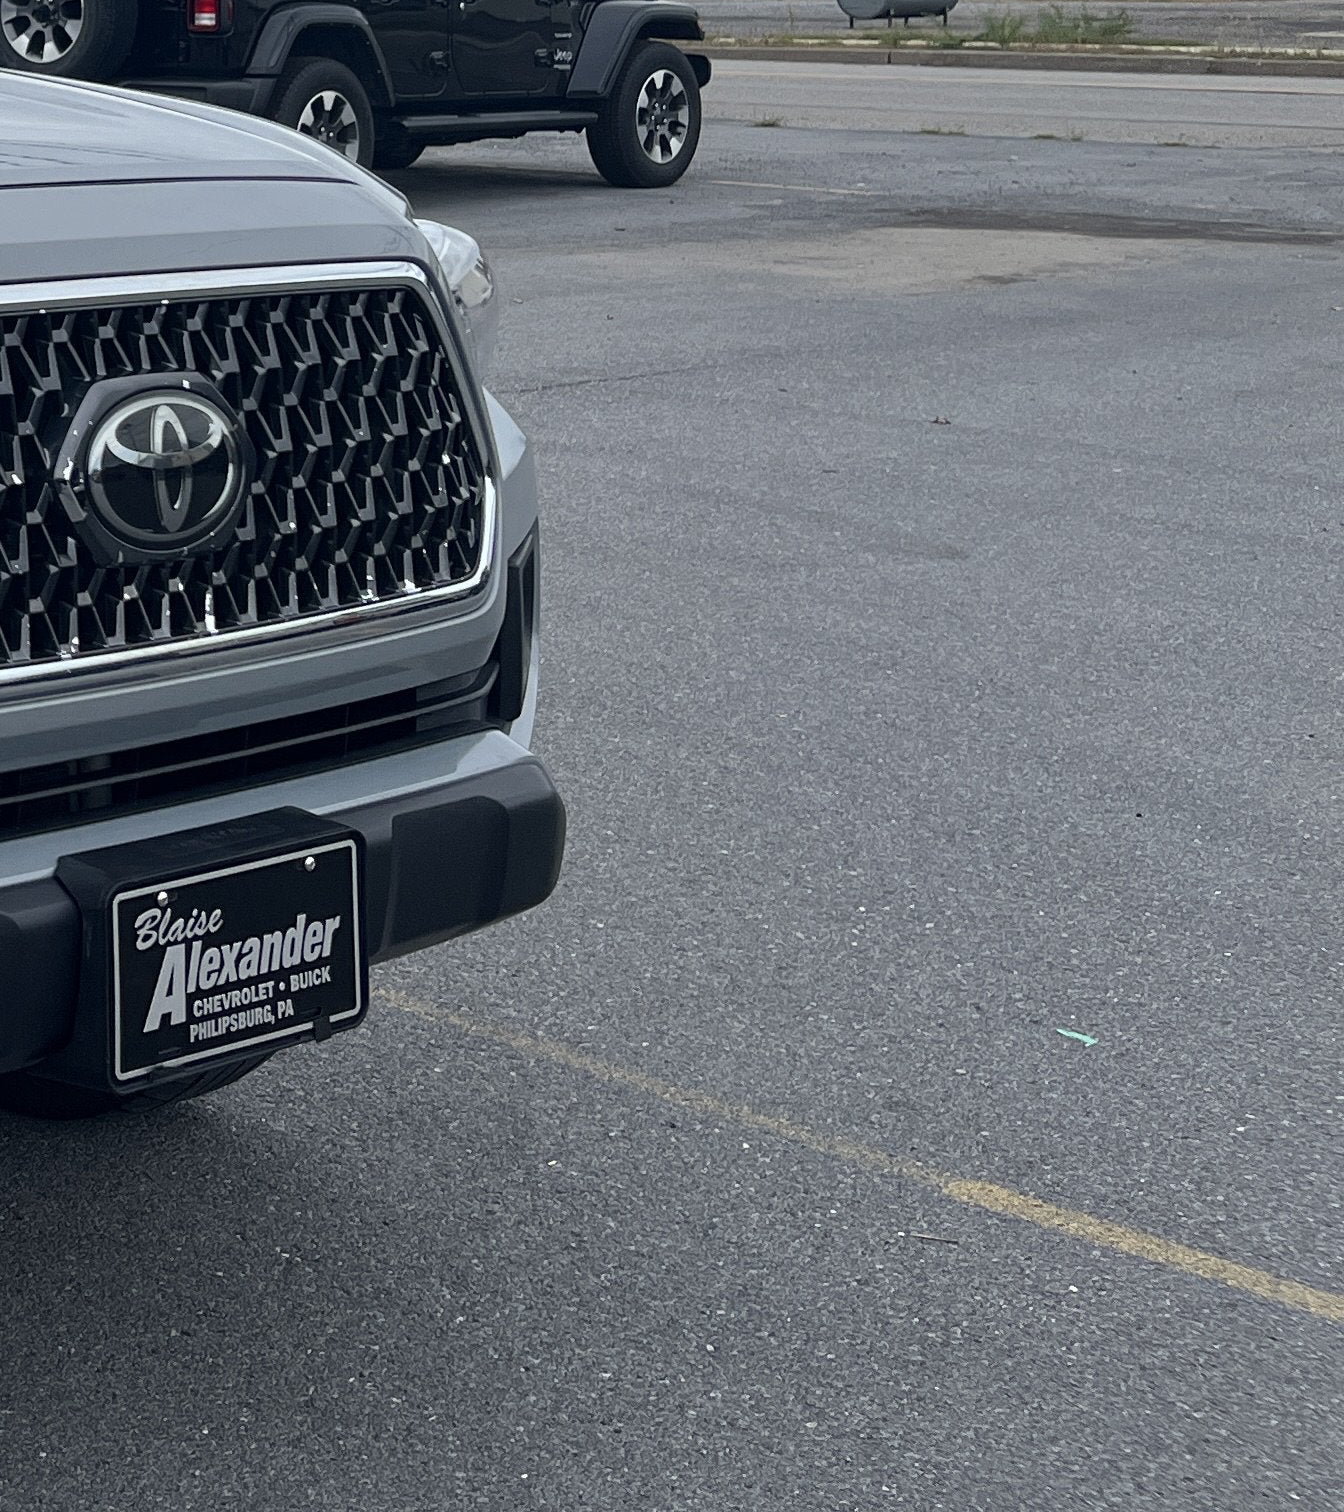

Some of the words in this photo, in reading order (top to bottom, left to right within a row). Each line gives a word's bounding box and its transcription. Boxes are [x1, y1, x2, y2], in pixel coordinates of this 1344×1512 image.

[134, 907, 224, 951] Blaise
[143, 913, 342, 1034] Alexander
[193, 980, 275, 1018] CHEVROLET
[290, 965, 332, 993] BUICK
[189, 1005, 276, 1044] PHILIPSBURG,
[277, 998, 295, 1020] PA
